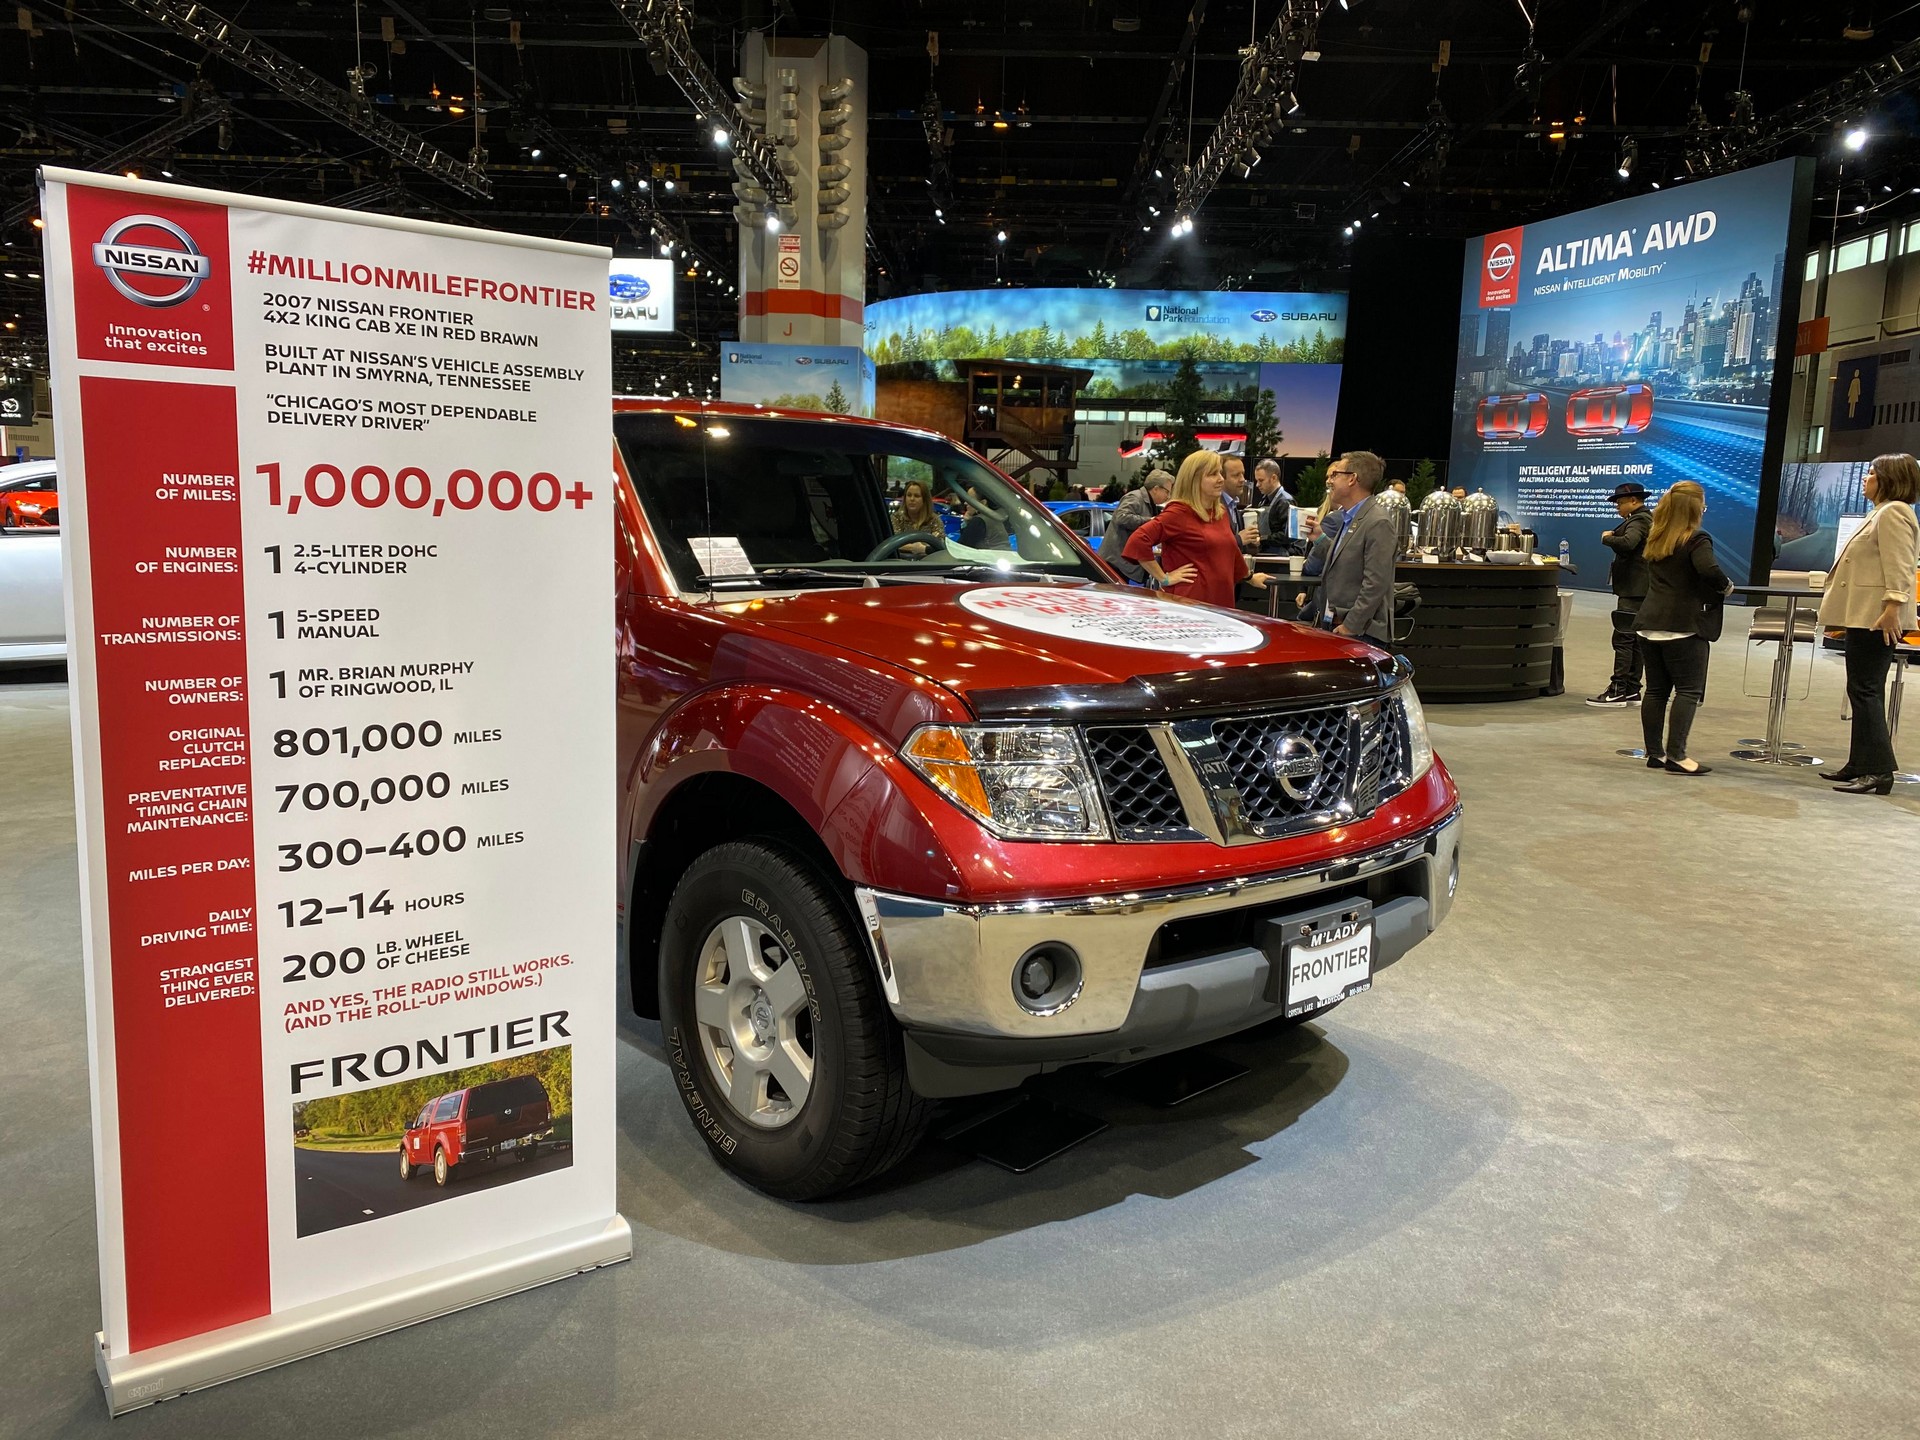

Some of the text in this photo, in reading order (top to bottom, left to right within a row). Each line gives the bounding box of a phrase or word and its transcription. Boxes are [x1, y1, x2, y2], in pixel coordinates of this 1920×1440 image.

[1536, 211, 1716, 275] ALTIMA AWD
[105, 250, 198, 273] NISSAN
[1490, 258, 1512, 266] NISSAN
[248, 249, 597, 312] #MILLIONMILEFRONTIER
[1534, 264, 1662, 296] NISSAN INTELLIGENT MOBILITY
[264, 293, 473, 325] 2007 NISSAN FRONTIER
[610, 306, 658, 320] BARU
[1163, 306, 1199, 315] National
[1163, 314, 1230, 323] Park Foundation
[1281, 313, 1337, 321] SUBARU
[108, 323, 202, 343] Innovation
[264, 310, 537, 347] 4X2 KING CAB XE IN RED BRAWN
[783, 322, 792, 336] J
[105, 337, 207, 354] that excites
[266, 344, 584, 380] BUILT AT NISSAN'S VEHICLE ASSEMBLY
[266, 361, 530, 392] PLANT IN SMYRNA, TENNESSEE
[268, 411, 357, 427] DELIVERY
[378, 401, 426, 415] MOST
[432, 405, 536, 422] DEPENDABLE
[1520, 464, 1653, 475] INTELLIGENT ALL-WHEEL DRIVE
[163, 474, 234, 486] NUMBER
[256, 462, 592, 516] 1,000,000+
[156, 489, 235, 500] OF MILES:
[166, 548, 236, 558] NUMBER
[264, 545, 280, 573] 1
[294, 545, 437, 557] 2.5-LITER DOHC
[136, 562, 238, 572] OF ENGINES:
[294, 562, 406, 574] 4-CYLINDER
[143, 616, 240, 628] NUMBER OF
[268, 611, 284, 639] 1
[298, 609, 379, 622] 5-SPEED
[101, 630, 240, 644] TRANSMISSIONS:
[298, 625, 379, 638] MANUAL
[299, 662, 474, 681] MR. BRIAN MURPHY
[146, 677, 242, 691] NUMBER OF
[270, 671, 286, 698] 1
[299, 679, 453, 698] OF RINGWOOD, IL
[169, 691, 243, 704] OWNERS:
[169, 727, 244, 741] ORIGINAL
[274, 720, 502, 758] 801,000 MILES
[184, 741, 244, 754] CLUTCH
[160, 755, 245, 770] REPLACED:
[128, 783, 247, 805] PREVENTATIVE
[276, 772, 509, 812] 700,000 MILES
[136, 798, 246, 818] TIMING CHAIN
[127, 811, 248, 833] MAINTENANCE:
[478, 832, 524, 848] MILES
[130, 858, 250, 882] MILES PER DAY:
[406, 893, 464, 912] HOURS
[210, 908, 252, 926] DAILY
[142, 922, 252, 946] DRIVING TIME:
[377, 930, 463, 954] LB. WHEEL
[1311, 922, 1358, 947] M'LADY
[283, 947, 365, 982] 200
[377, 943, 470, 969] OF CHEESE
[742, 888, 821, 1022] GRABBER
[160, 957, 254, 979] STRANGEST
[1292, 945, 1368, 986] FRONTIER
[160, 972, 254, 994] THING EVER
[284, 955, 573, 1016] AND YES, THE RADIO STILL WORKS.
[164, 984, 255, 1007] DELIVERED:
[286, 974, 542, 1033] (AND THE ROLL-UP WINDOWS.)
[1304, 1003, 1313, 1012] LAKE
[290, 1010, 572, 1094] FRONTIER
[669, 1026, 738, 1155] GENERAL
